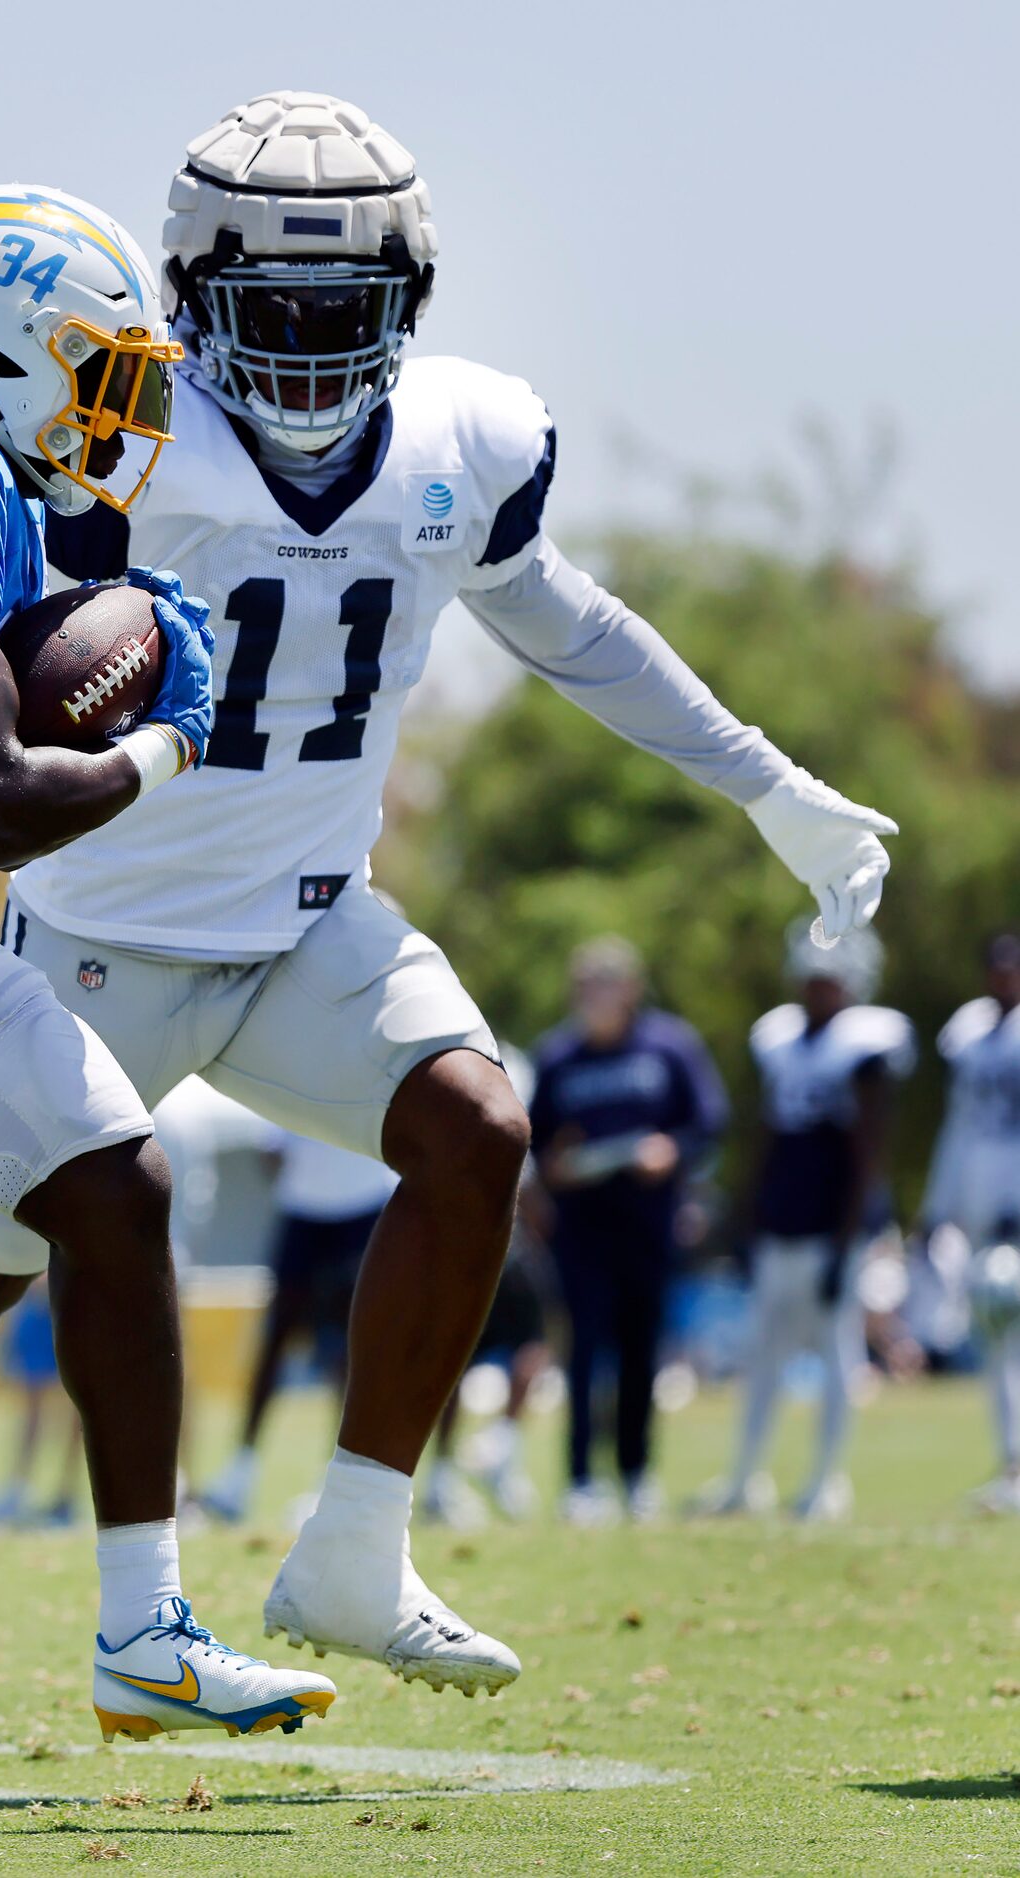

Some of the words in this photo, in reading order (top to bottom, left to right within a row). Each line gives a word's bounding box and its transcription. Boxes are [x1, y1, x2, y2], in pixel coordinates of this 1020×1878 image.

[416, 525, 455, 542] AT&T
[277, 546, 349, 559] COWBOYS
[204, 578, 394, 771] 11
[80, 970, 104, 988] NFL
